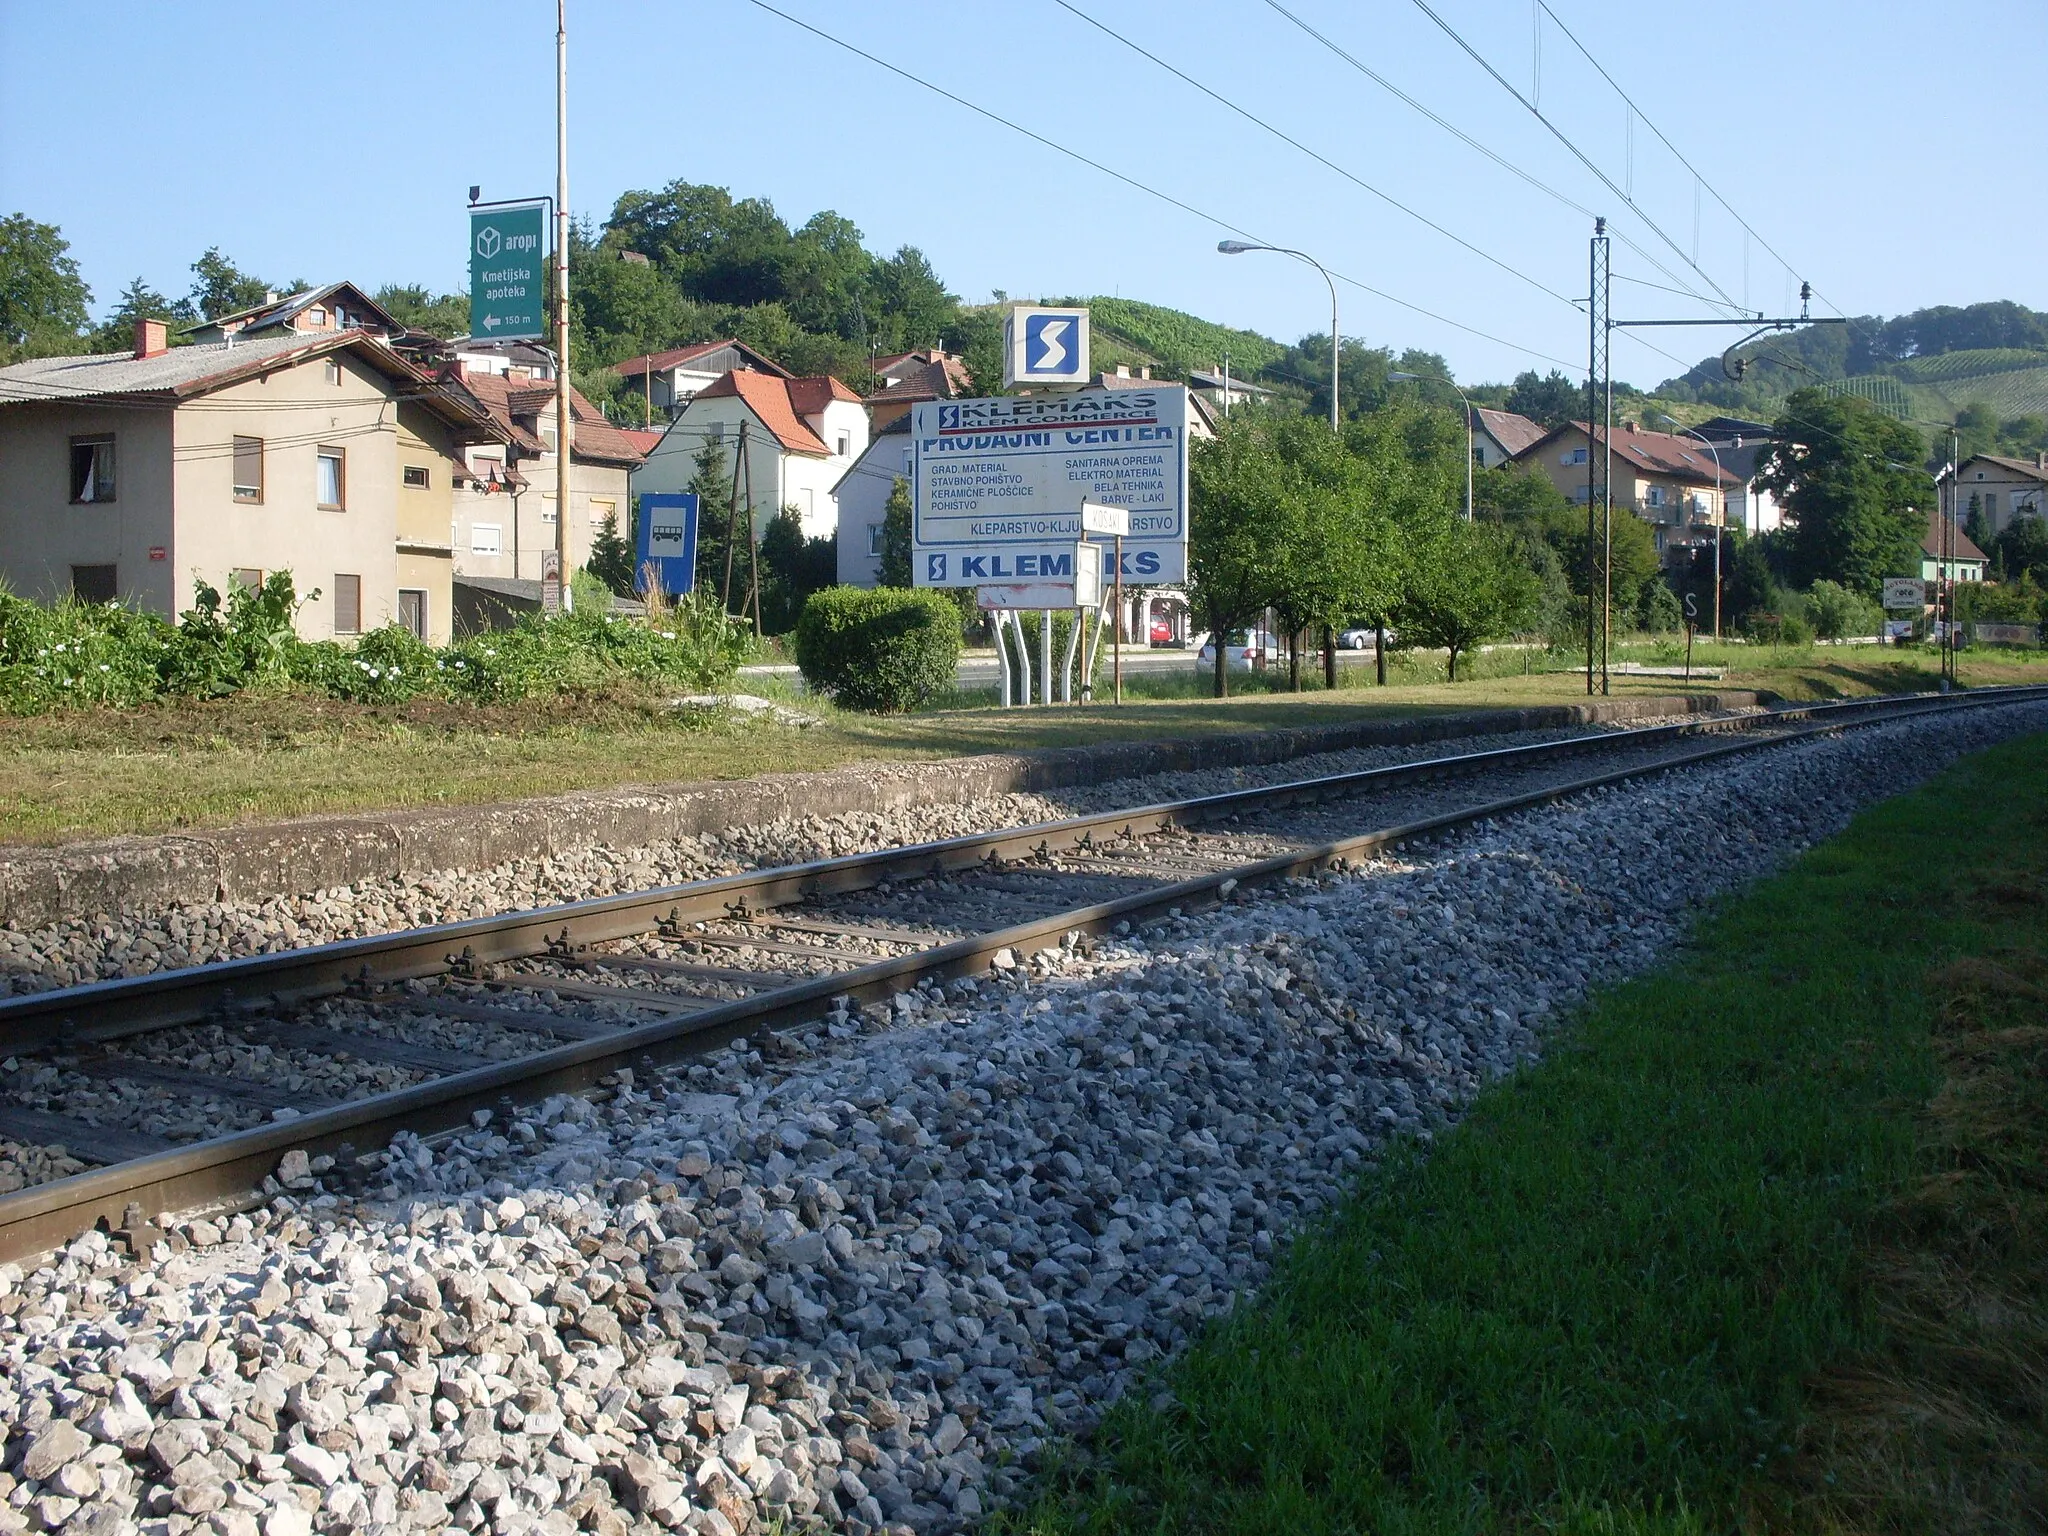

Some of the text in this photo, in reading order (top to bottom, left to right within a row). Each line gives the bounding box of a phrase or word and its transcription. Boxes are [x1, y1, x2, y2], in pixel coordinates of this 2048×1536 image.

[482, 268, 530, 283] Kmetijska
[486, 286, 525, 300] apoteka
[505, 315, 519, 324] 150
[962, 393, 1157, 418] KLEMAKS
[962, 410, 1157, 427] KLEM COMMERCE
[1066, 456, 1163, 468] SANITARNA OPREMA
[932, 464, 1007, 474] GRAD. MATERIAL
[1069, 468, 1163, 480] ELEKTRO MATERIAL
[932, 474, 1022, 486] STAVBNO POHIŠTVO
[932, 486, 1033, 498] KERAMIČNE PLOŠČICE
[1095, 481, 1163, 492] BELA TEHNIKA
[931, 499, 977, 510] POHIŠTVO
[1102, 495, 1134, 504] BARVE
[1143, 493, 1164, 502] LAKI
[962, 551, 1160, 577] KLEMKS
[1686, 592, 1697, 616] S
